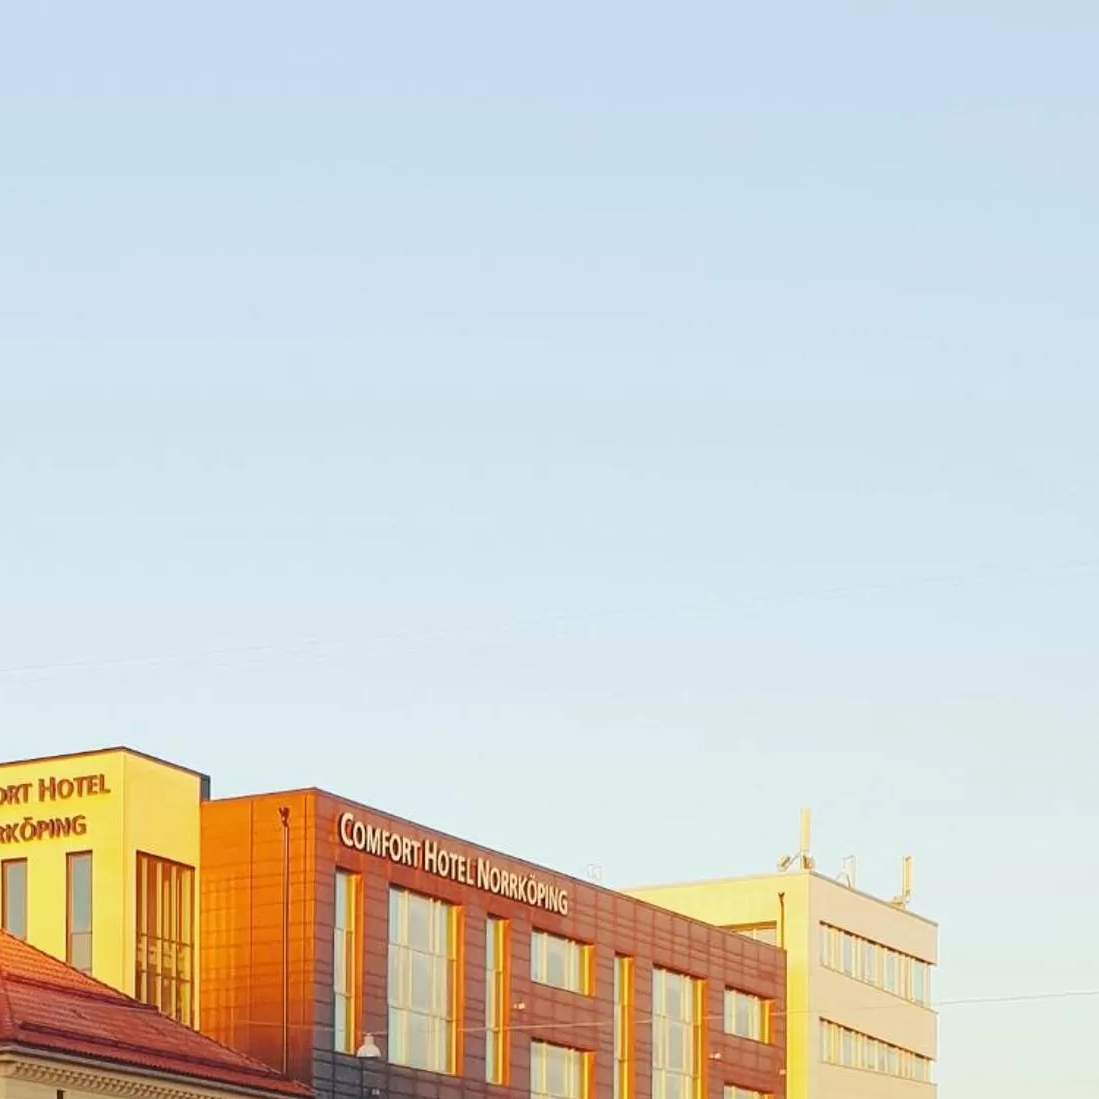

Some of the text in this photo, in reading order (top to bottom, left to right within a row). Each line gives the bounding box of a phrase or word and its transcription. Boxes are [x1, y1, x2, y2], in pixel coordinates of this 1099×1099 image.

[37, 773, 111, 801] HOTEL
[340, 812, 569, 915] COMFORT HOTEL NORRKÖPING
